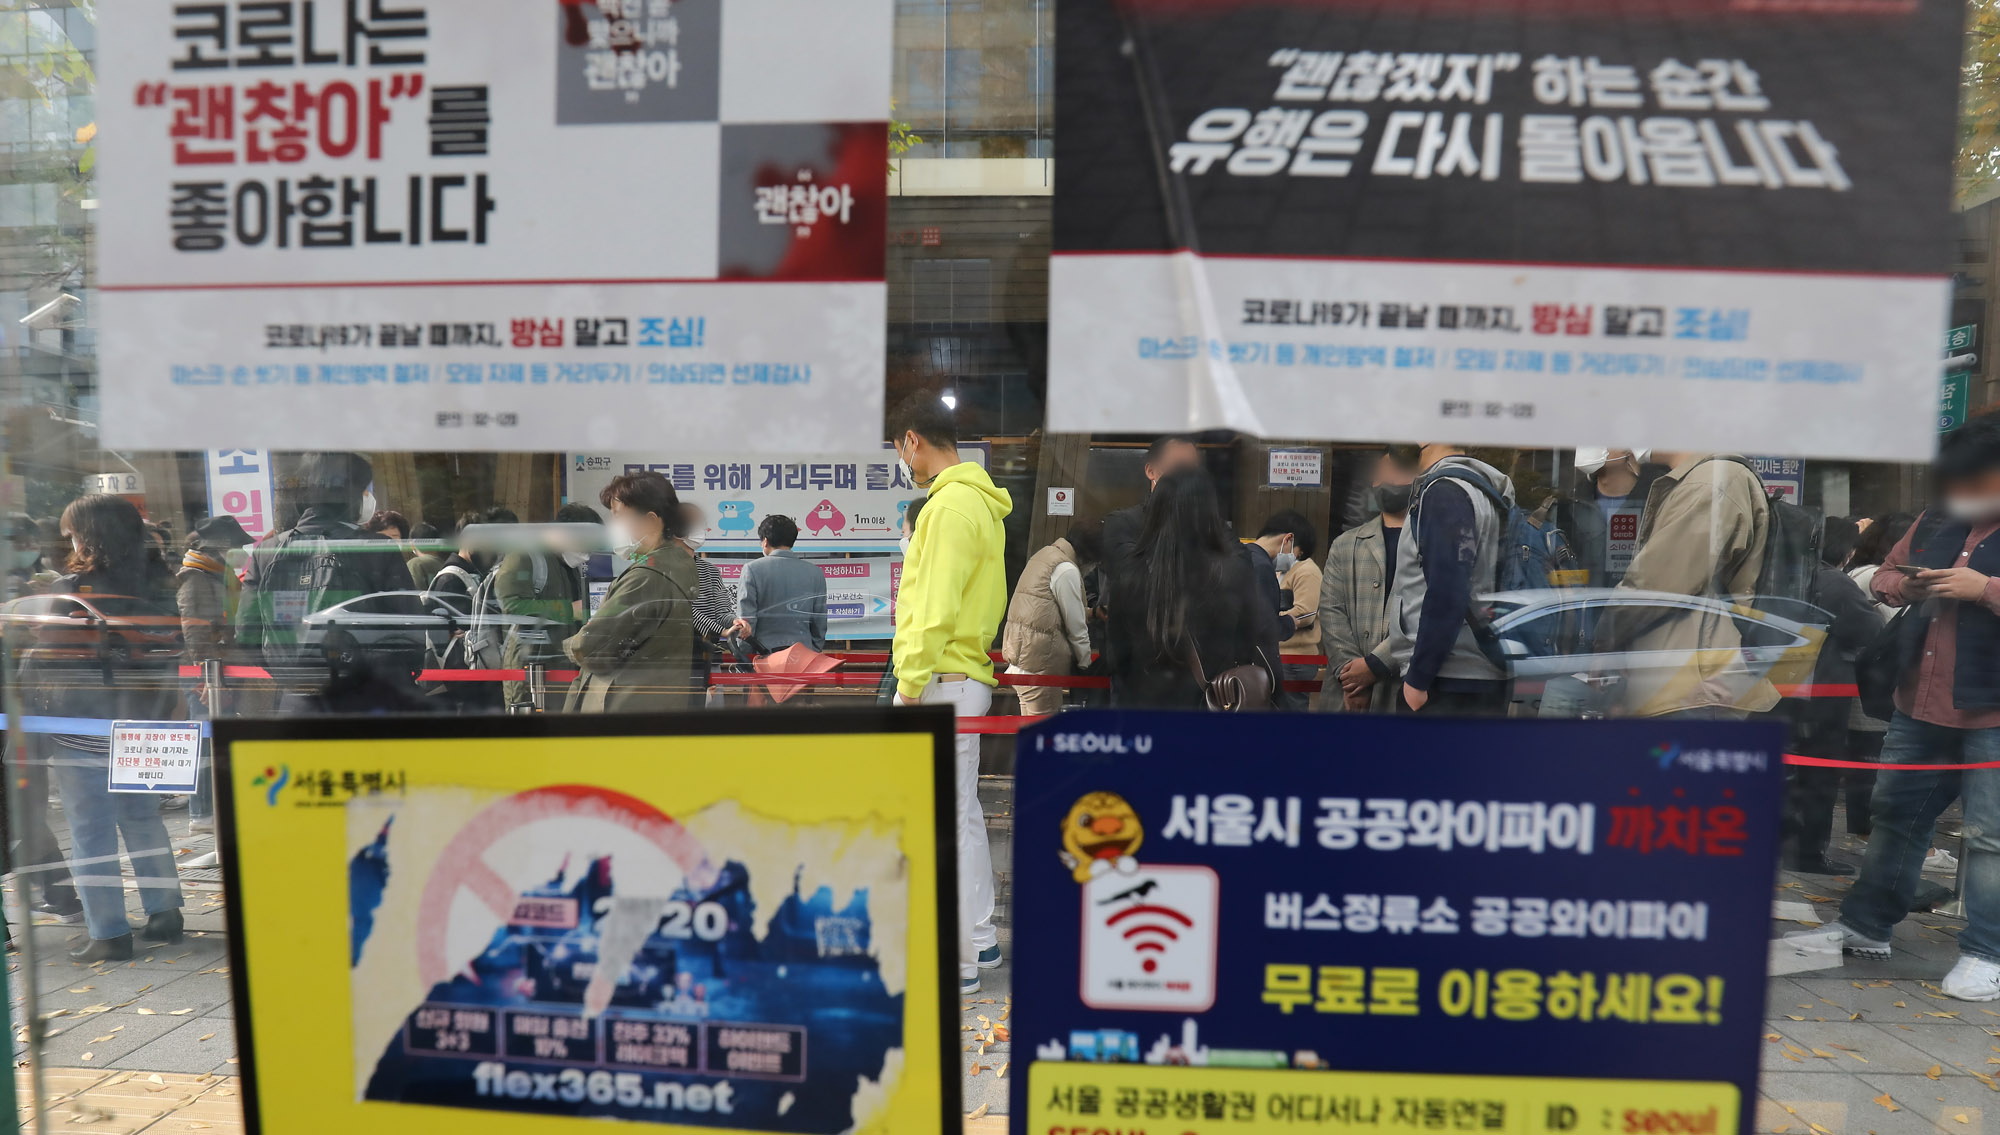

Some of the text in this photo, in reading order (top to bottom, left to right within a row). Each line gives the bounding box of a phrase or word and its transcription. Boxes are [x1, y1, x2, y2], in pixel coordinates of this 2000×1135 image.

[171, 0, 429, 70] 코로나는
[583, 49, 681, 89] 괜찮아
[1532, 55, 1643, 107] 하는
[1650, 58, 1770, 111] 순간
[1169, 107, 1852, 191] 유행은 다시 돌아옵니다
[170, 174, 495, 251] 좋아합니다
[754, 184, 854, 224] 괜찮아
[265, 324, 371, 350] 코로나19가
[379, 324, 422, 348] 끝날
[511, 318, 564, 347] 방심
[575, 317, 628, 347] 말고
[638, 317, 705, 347] 조심!
[1242, 299, 1369, 327] 코로나19가
[1378, 303, 1429, 329] 끝날
[1532, 303, 1592, 336] 방심
[1604, 305, 1665, 337] 말고
[586, 457, 611, 467] 송파구
[704, 463, 751, 490] 위해
[760, 463, 856, 490] 거리두며
[1782, 459, 1799, 474] 동안
[854, 514, 886, 524] 1m 이상
[824, 566, 864, 575] 작성하시고
[124, 746, 142, 754] 코로나
[162, 746, 189, 754] 대기자는
[1053, 733, 1128, 753] SEOUL
[1135, 734, 1152, 753] U
[1678, 749, 1767, 771] 서울특별시
[178, 759, 191, 767] 대기
[294, 768, 406, 797] 서울특별시
[1162, 795, 1749, 856] 서울시 공공와이파이 까치온
[1264, 892, 1708, 940] 버스정류소 공공와이파이
[1262, 964, 1725, 1025] 무료로 이용하세요!
[474, 1061, 734, 1113] flex365.net
[1048, 1085, 1506, 1130] 서울 공공생활권 어디서나 자동연결
[1546, 1103, 1578, 1130] ID
[1623, 1106, 1718, 1134] seoul
